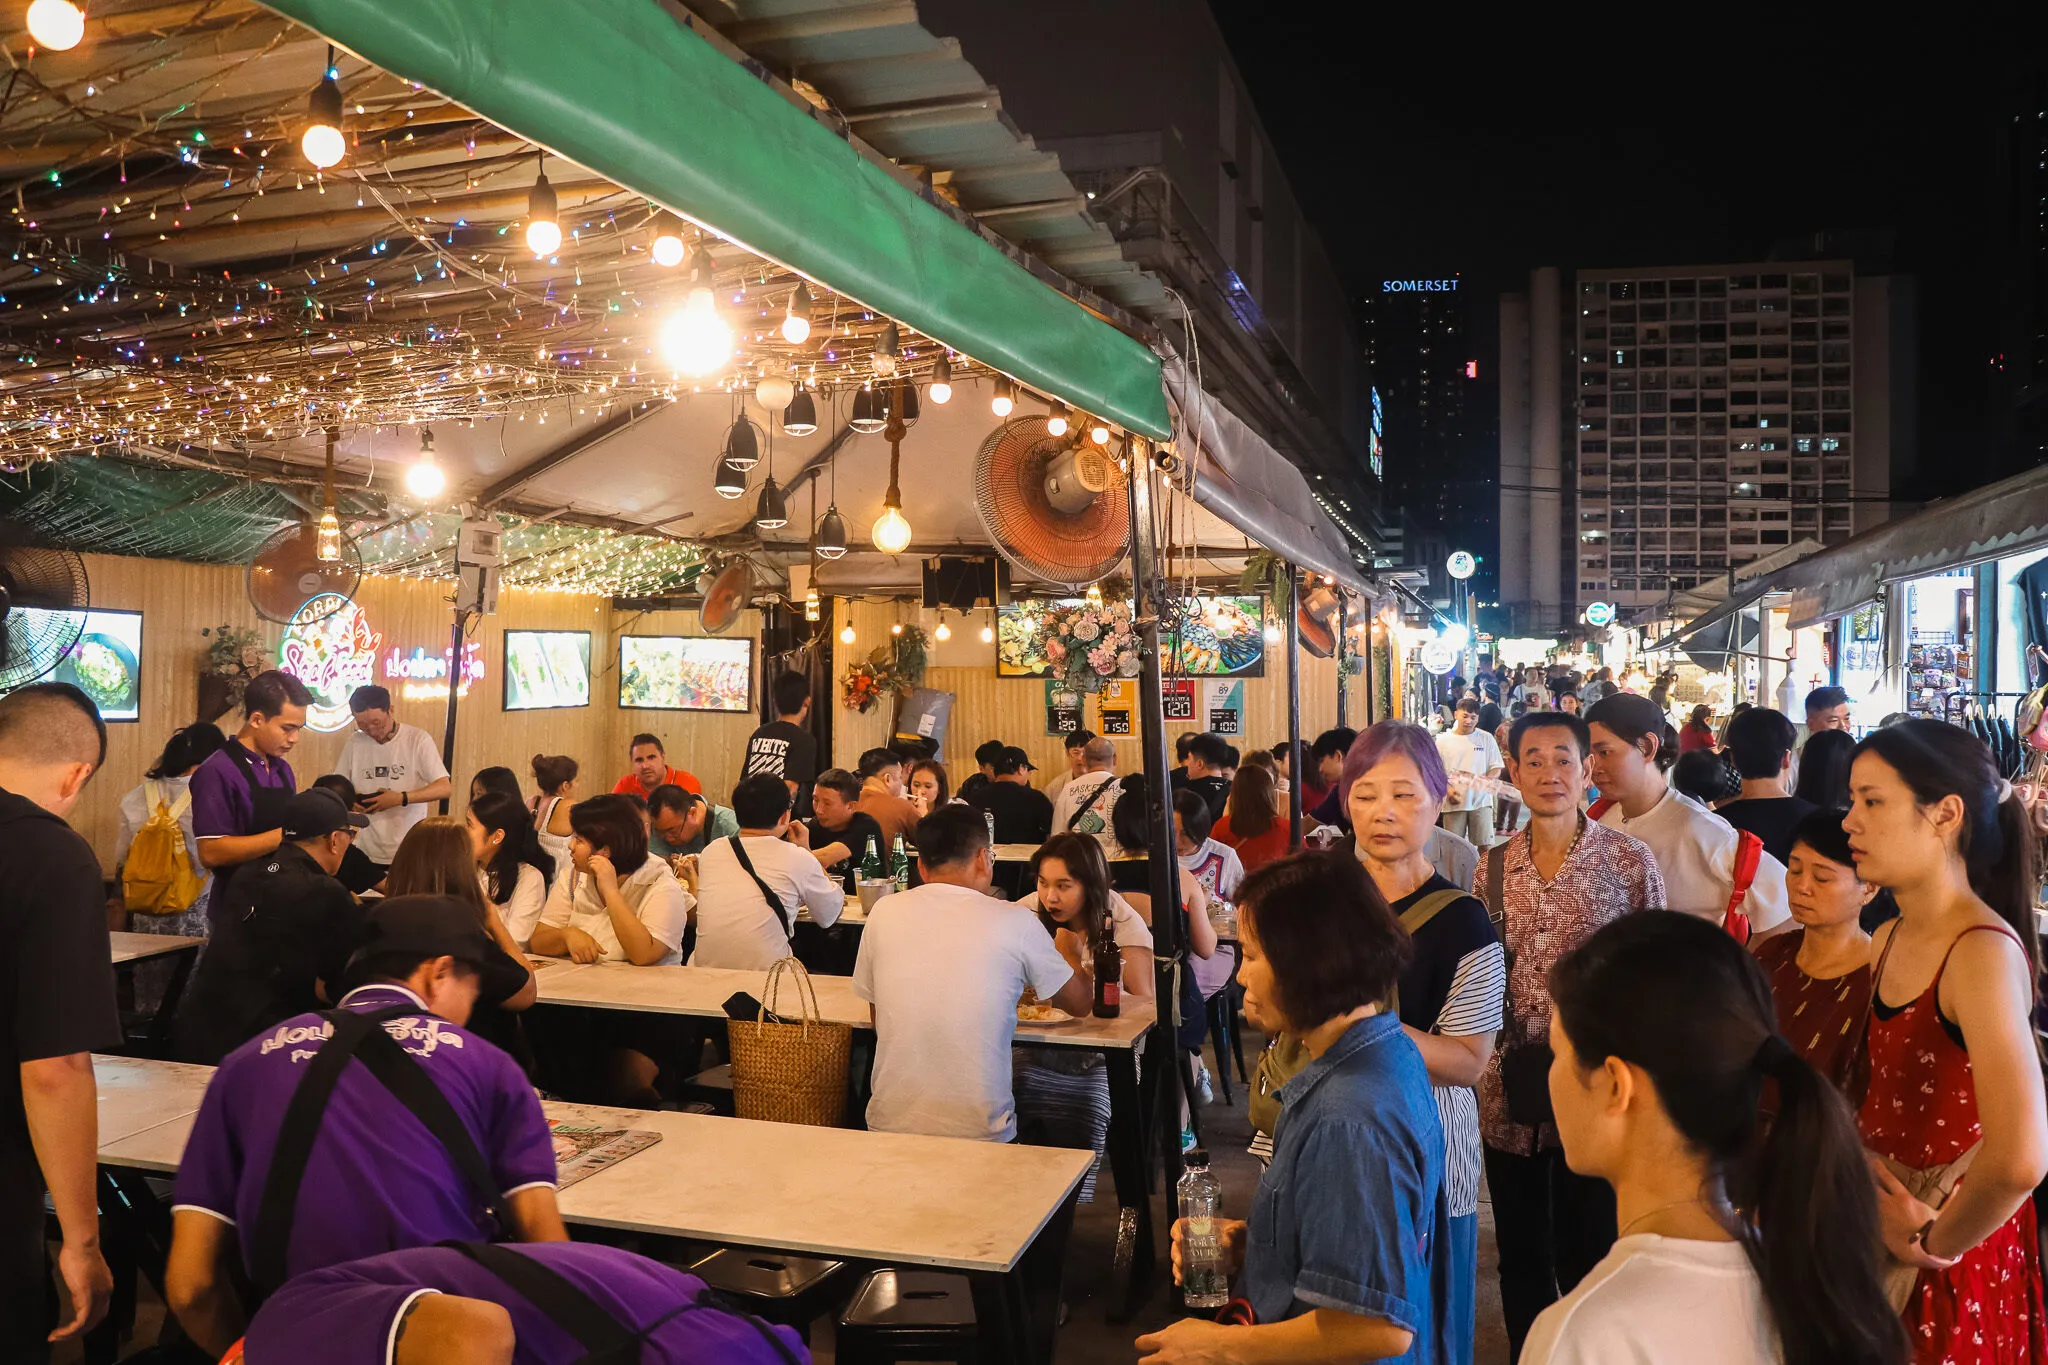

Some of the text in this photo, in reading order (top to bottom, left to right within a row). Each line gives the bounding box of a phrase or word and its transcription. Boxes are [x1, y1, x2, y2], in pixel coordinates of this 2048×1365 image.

[1383, 280, 1458, 292] SOMERSET
[1168, 702, 1190, 717] 120
[1113, 722, 1129, 733] 150
[1220, 722, 1237, 732] 100
[752, 738, 790, 756] WHITE
